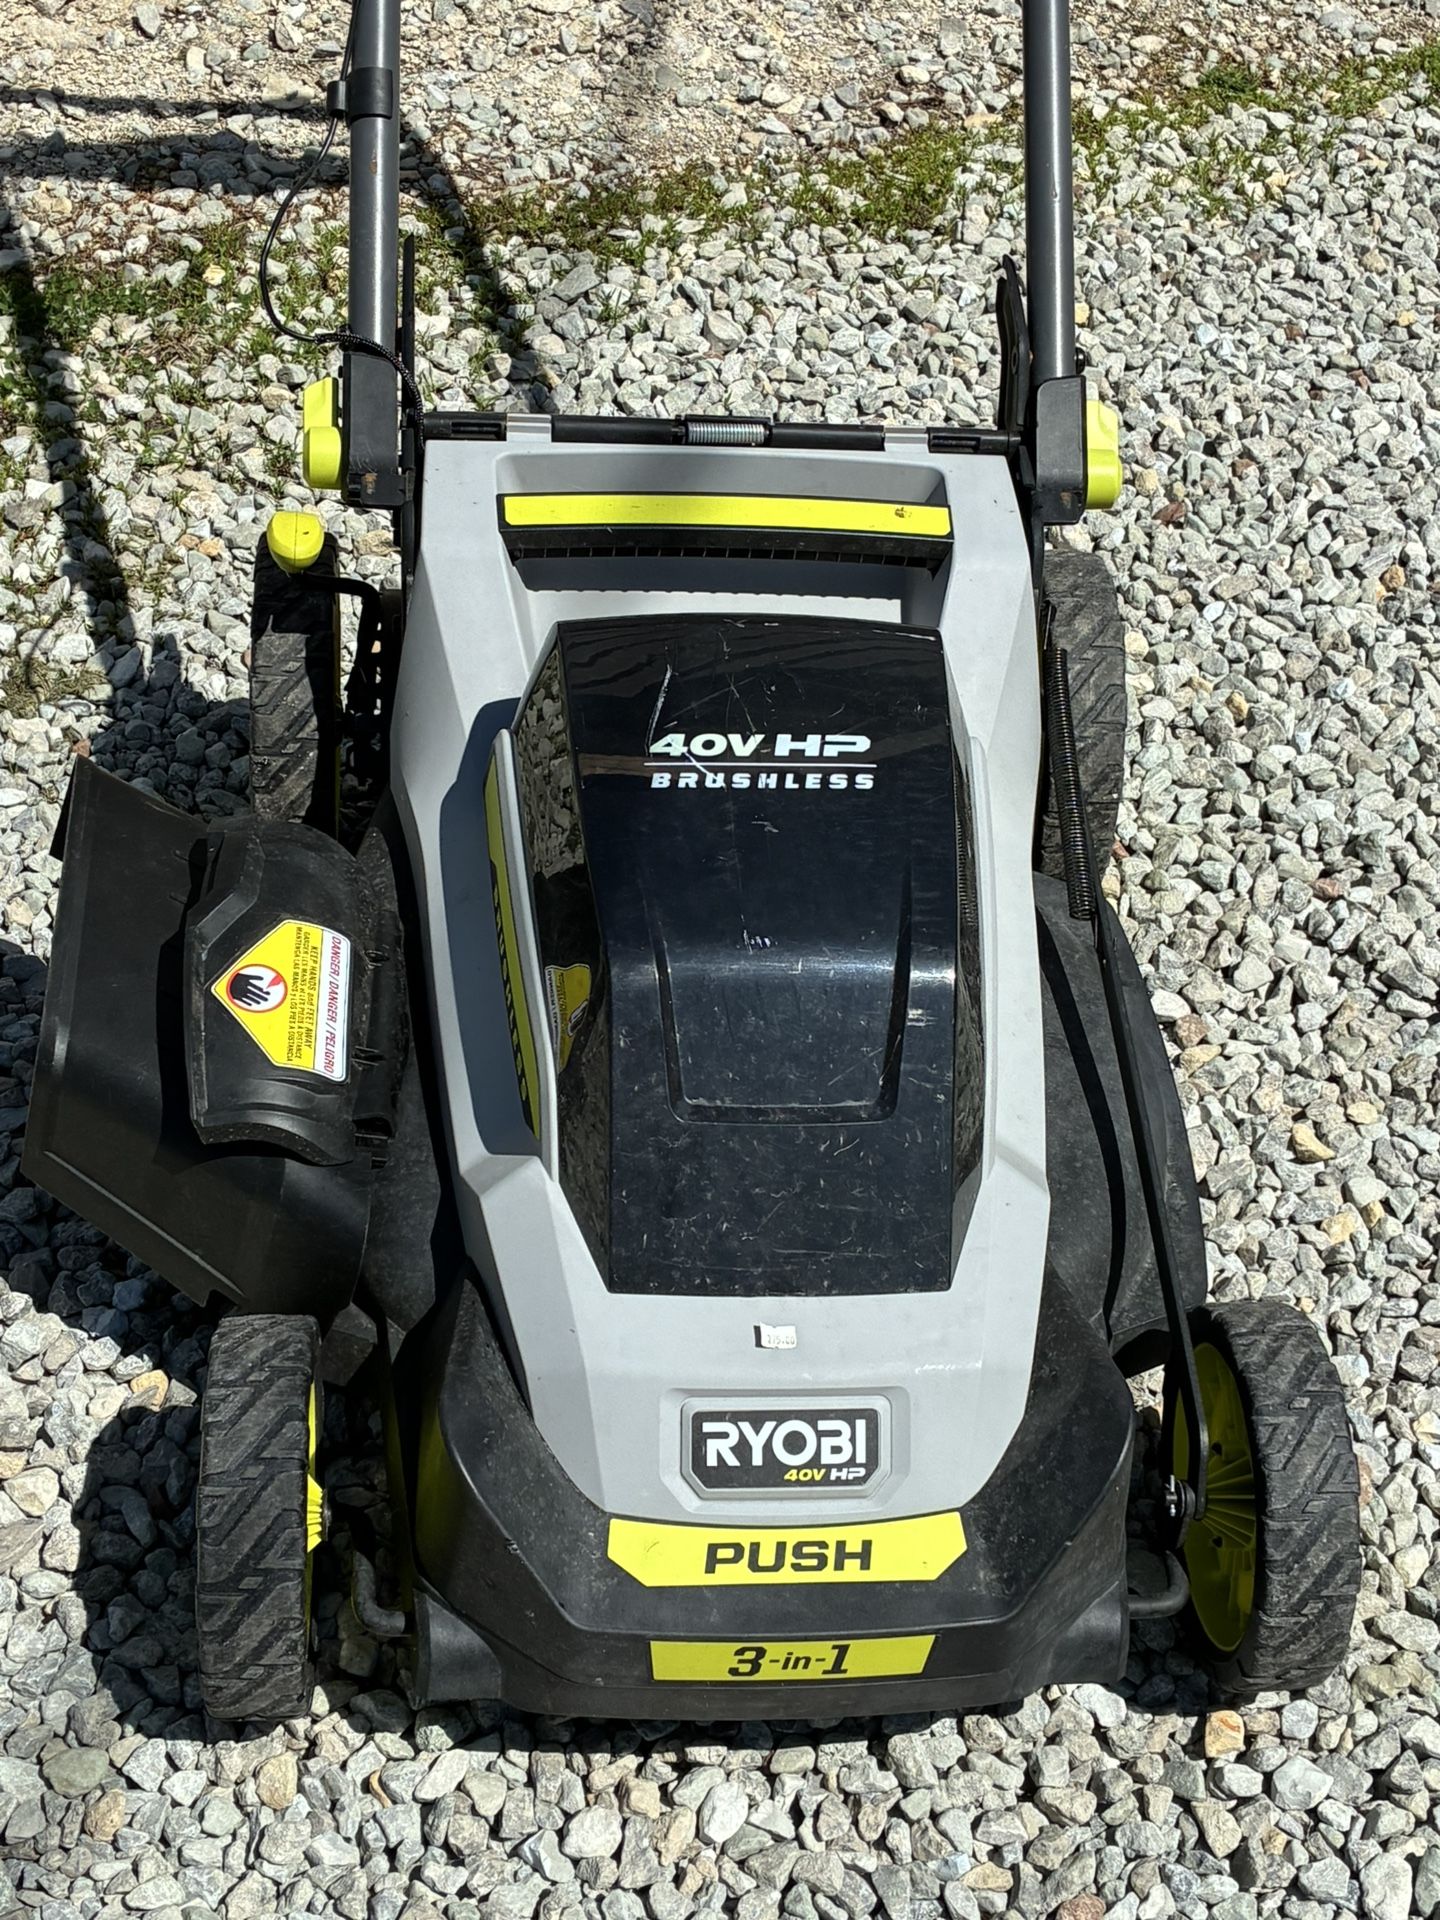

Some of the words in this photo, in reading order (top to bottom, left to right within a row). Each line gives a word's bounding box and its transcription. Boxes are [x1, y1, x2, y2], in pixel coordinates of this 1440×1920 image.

[649, 733, 765, 757] 40V
[774, 734, 871, 757] HP
[650, 773, 874, 790] BRUSHLESS
[294, 927, 303, 957] MANTENGA
[310, 945, 319, 965] KEEP
[291, 970, 300, 992] MANOS
[308, 965, 318, 991] HANDS
[307, 992, 315, 1006] and
[305, 1007, 315, 1026] FEET
[287, 1031, 296, 1062] DISTANCIA
[295, 1031, 303, 1059] DISTANCE
[304, 1027, 314, 1049] AWAY
[323, 1030, 336, 1074] PELIGRO
[702, 1419, 867, 1467] RYOBI
[783, 1467, 826, 1481] 40V
[830, 1467, 867, 1480] HP
[704, 1540, 873, 1575] PUSH
[727, 1644, 851, 1678] 3-in-1
